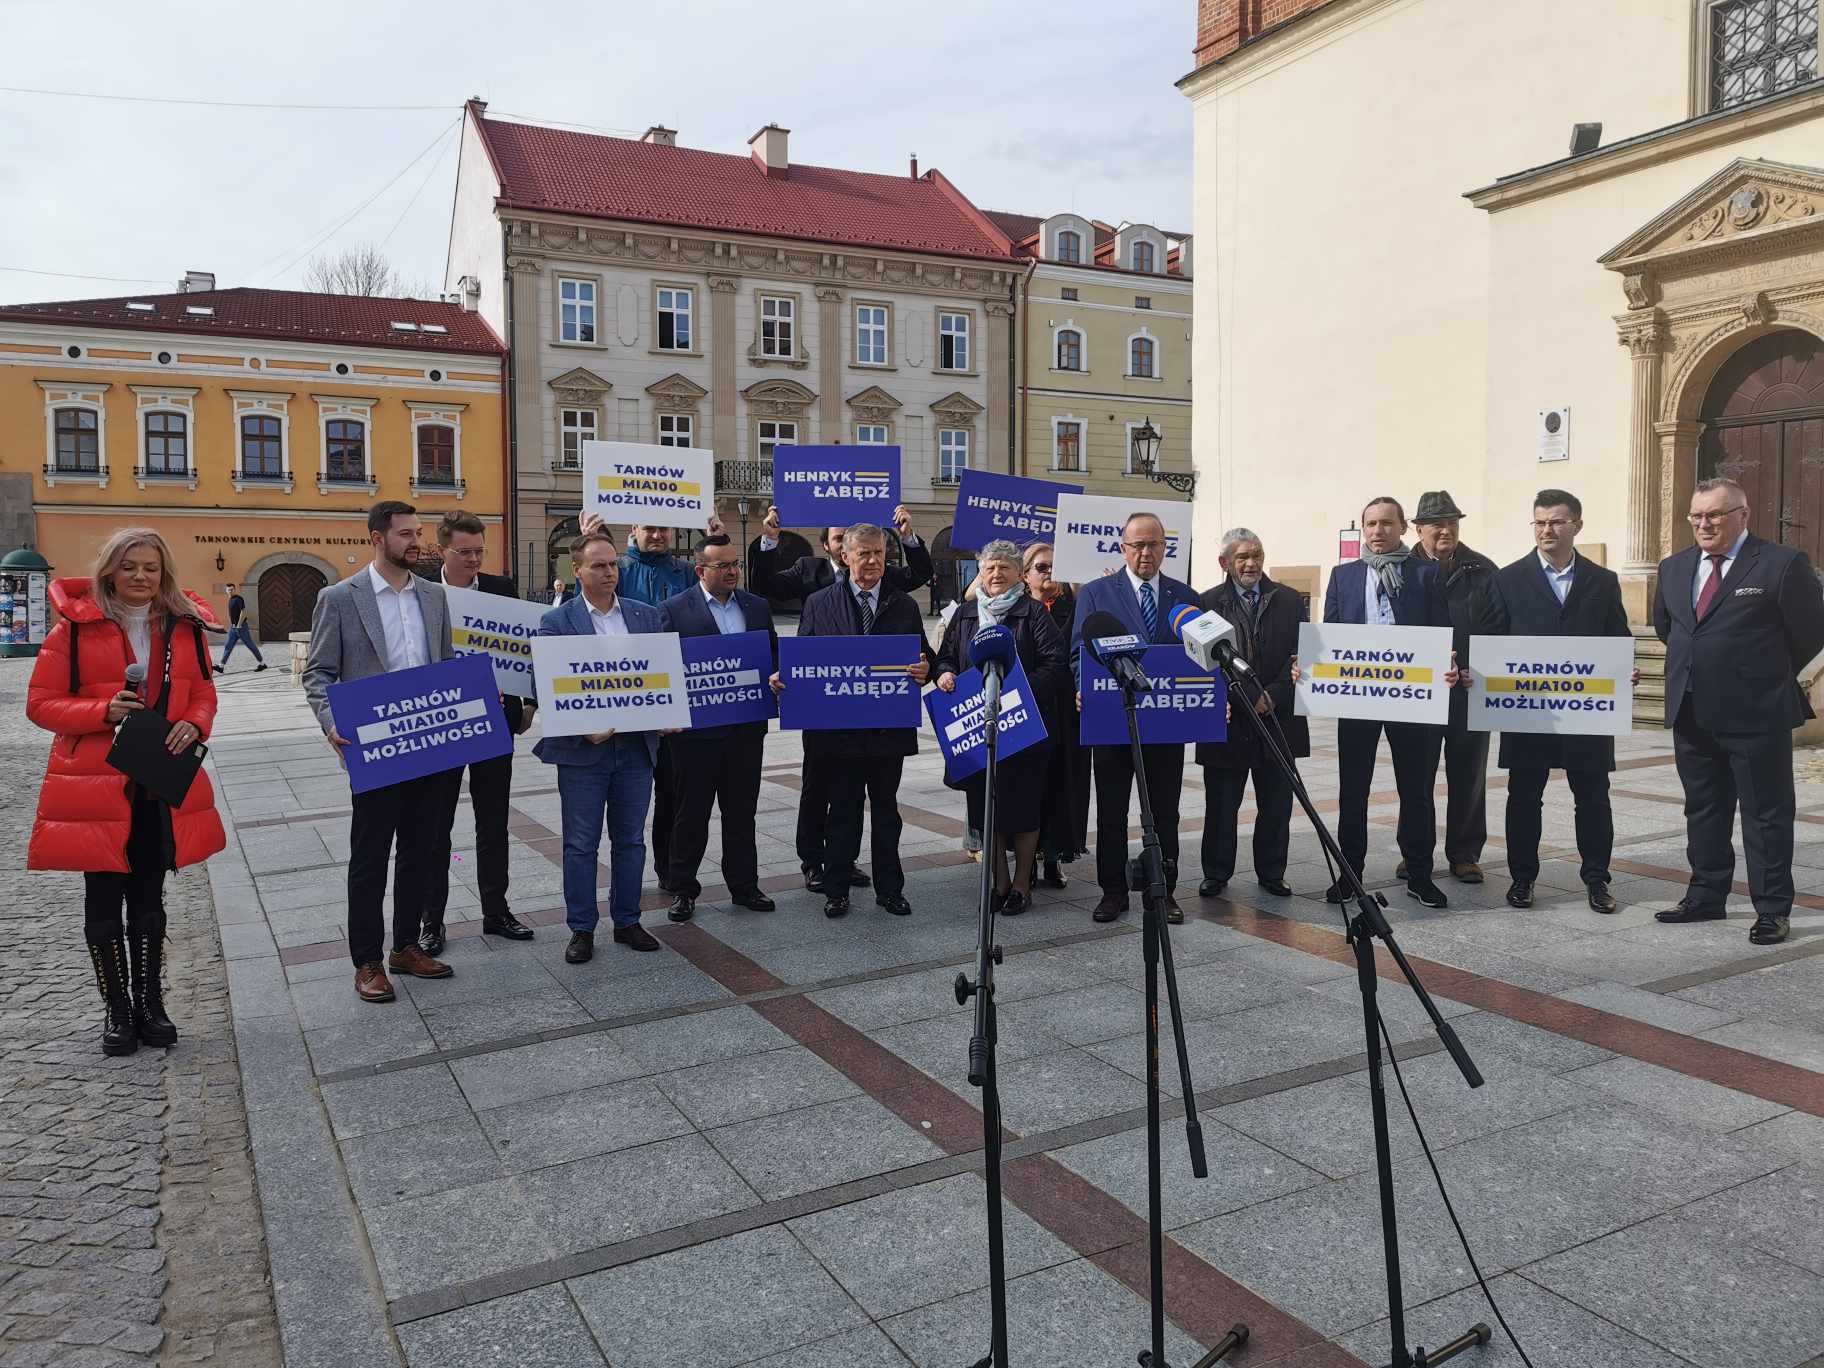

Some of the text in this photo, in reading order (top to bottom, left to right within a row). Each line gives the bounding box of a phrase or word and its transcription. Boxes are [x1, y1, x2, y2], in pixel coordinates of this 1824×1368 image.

[614, 464, 684, 478] TARNÓW
[784, 471, 852, 482] HENRYK
[622, 479, 678, 492] MIA100
[813, 483, 890, 501] ŁABĘDŹ
[598, 492, 701, 510] MOŻLIWOŚCI
[967, 495, 1033, 515] HENRYK
[993, 513, 1057, 535] ŁABĘD
[1067, 522, 1125, 537] HENRY
[195, 535, 265, 544] TARNOWSKIE
[269, 537, 321, 545] CENTRUM
[1096, 540, 1179, 559] ŁAŹ
[468, 634, 532, 655] MIA100
[1332, 649, 1415, 663] TARNÓW
[569, 658, 649, 673] TARNÓW
[683, 657, 742, 674] ARNÓW
[791, 666, 867, 678] HENRYK
[1340, 666, 1405, 680] MIA100
[1506, 661, 1595, 675] TARNÓW
[581, 677, 644, 691] MIA100
[824, 678, 909, 699] ŁABĘDŹ
[1093, 677, 1172, 691] HEYK
[1311, 681, 1432, 700] MOŻLIWOŚCI
[1515, 680, 1585, 692] MIA100
[373, 688, 462, 718] TARNÓW
[555, 692, 673, 711] MOŻLIWOŚCI
[688, 688, 763, 708] LIWOŚCI
[1485, 695, 1615, 711] MOŻLIWOŚCI
[389, 708, 459, 735] MIA100
[362, 720, 493, 763] MOŻLIWOŚCI
[951, 709, 1028, 757] MOŻLOŚCI
